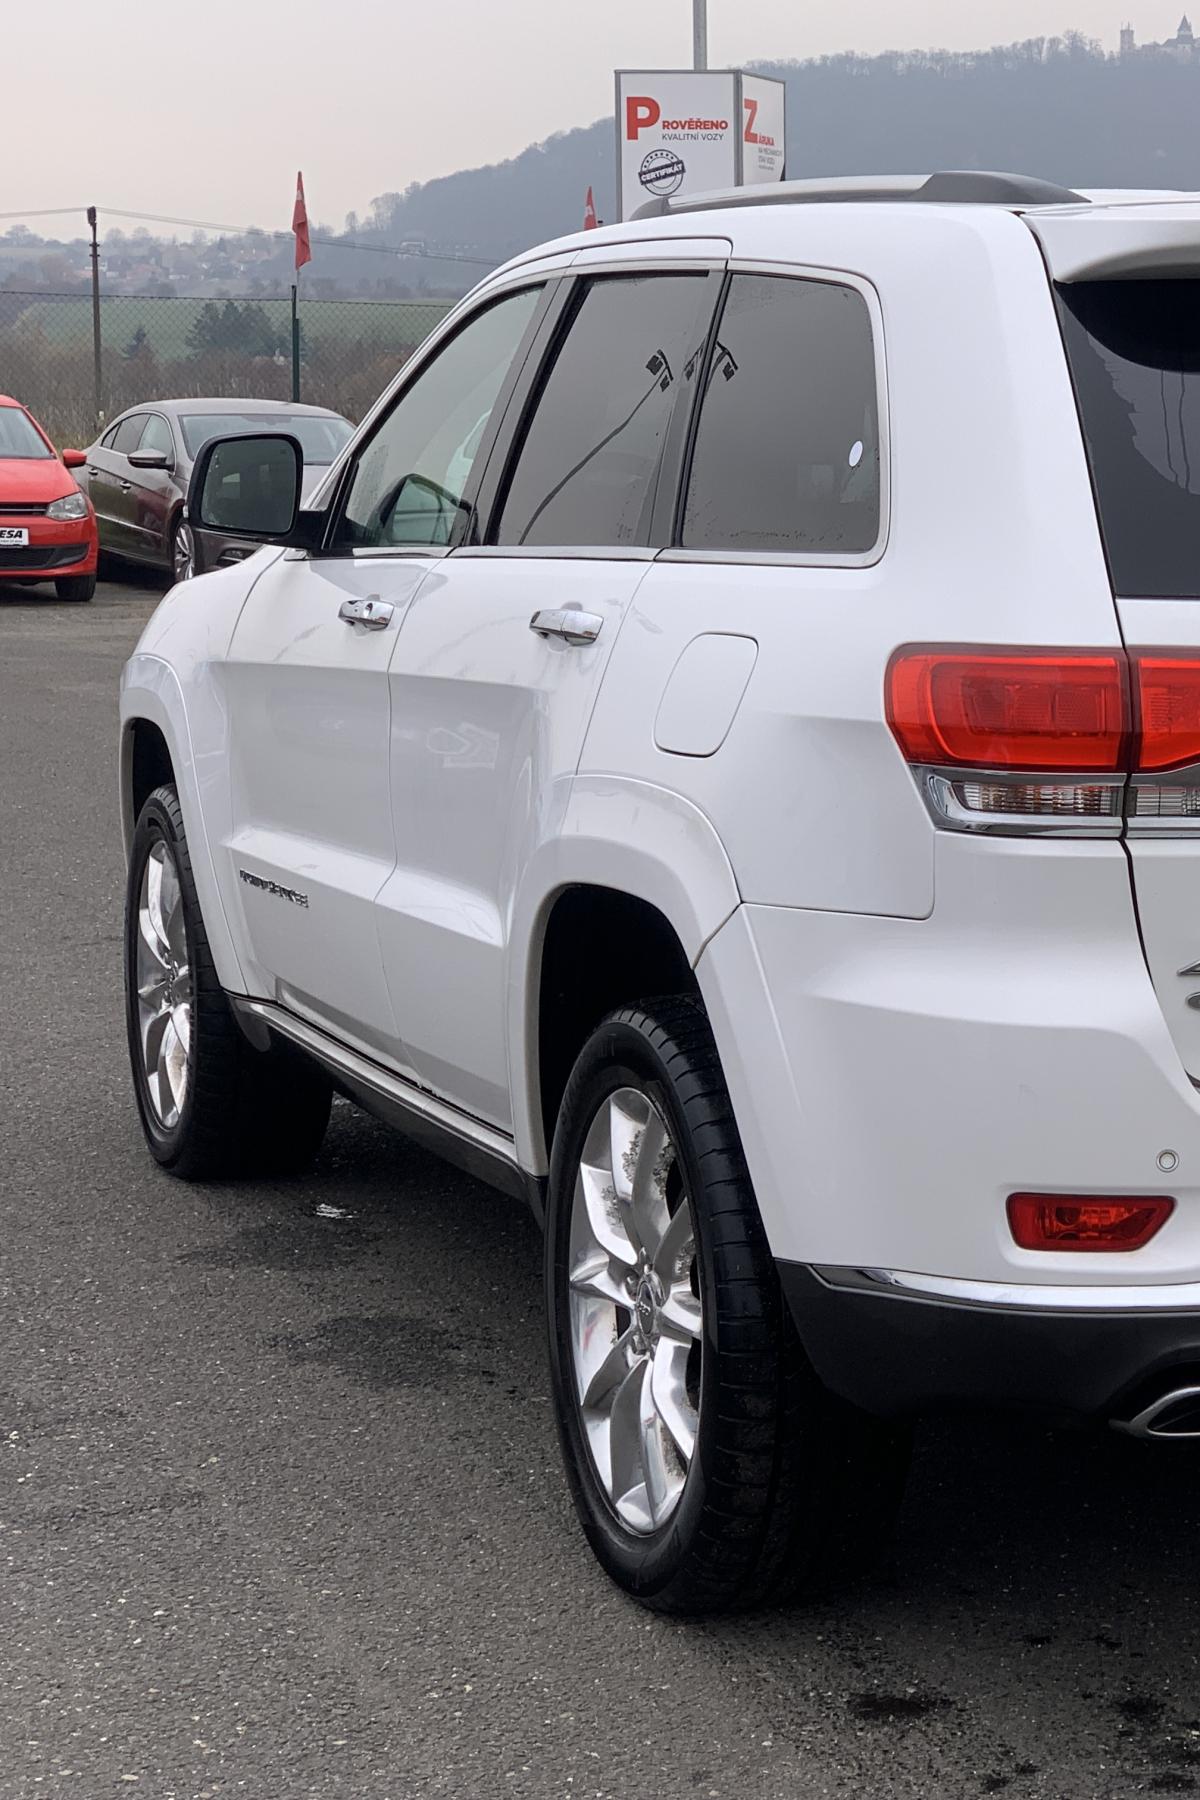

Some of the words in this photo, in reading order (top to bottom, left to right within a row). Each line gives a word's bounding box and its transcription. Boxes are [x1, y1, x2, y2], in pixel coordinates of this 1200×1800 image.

[662, 131, 699, 141] KVALITNÍ
[701, 133, 724, 141] VOZY
[640, 162, 684, 182] CERTIFIKÁT
[0, 530, 23, 538] ESA
